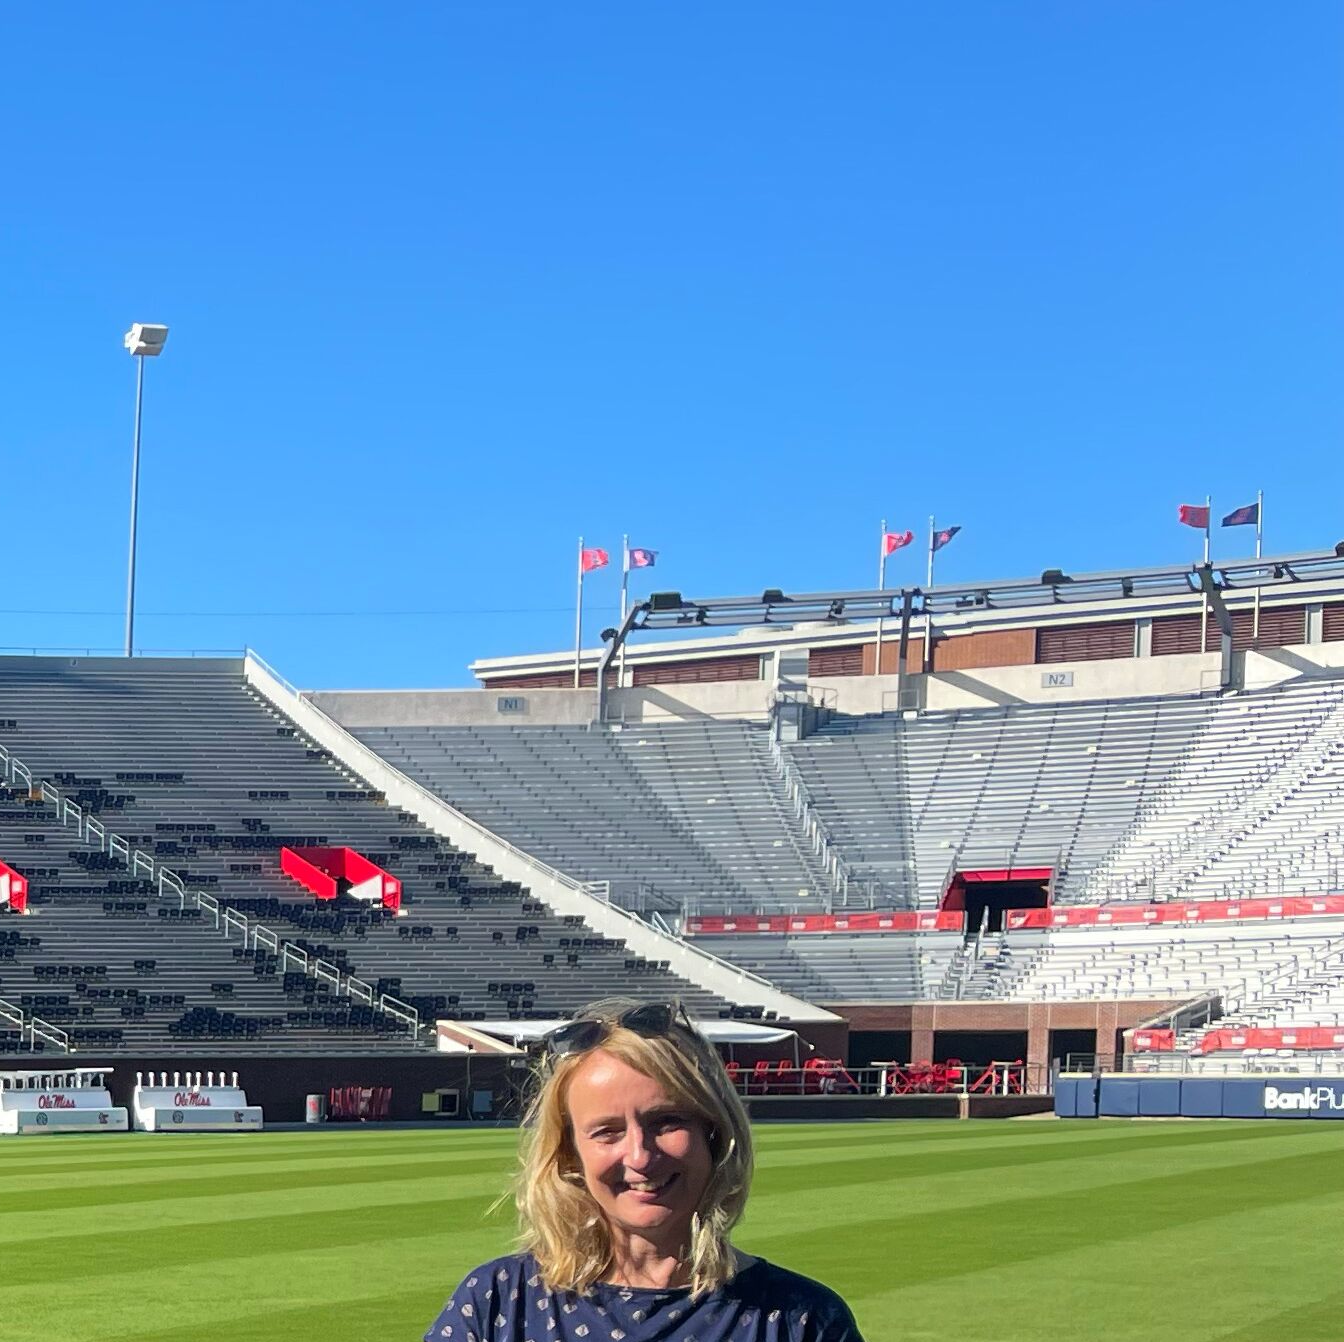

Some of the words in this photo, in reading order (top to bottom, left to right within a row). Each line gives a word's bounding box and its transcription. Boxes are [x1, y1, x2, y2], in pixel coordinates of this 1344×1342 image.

[1048, 674, 1066, 687] N2
[504, 699, 517, 709] N1
[38, 1094, 52, 1109] Ole
[52, 1094, 76, 1109] Miss
[174, 1091, 188, 1106] Ole
[187, 1091, 211, 1106] Miss
